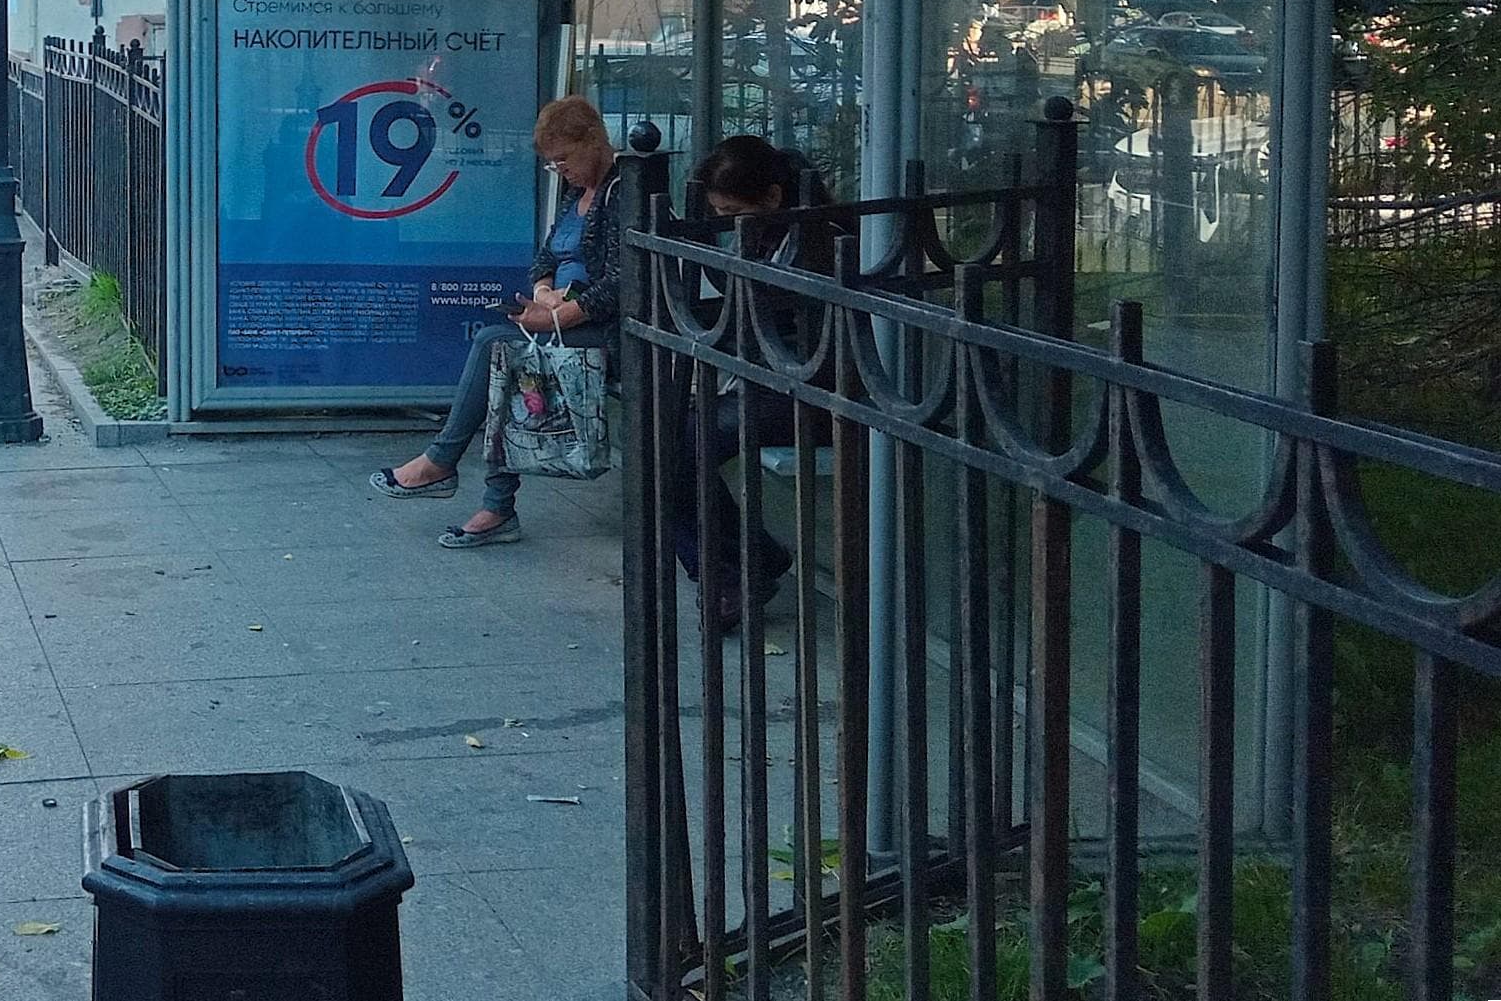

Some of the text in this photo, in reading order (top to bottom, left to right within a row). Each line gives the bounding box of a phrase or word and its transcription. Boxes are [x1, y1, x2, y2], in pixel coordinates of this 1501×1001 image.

[339, 3, 347, 14] к
[353, 0, 444, 19] большему
[234, 28, 505, 52] НАКОПИТЕЛЬНЫЙ СЧЁТ
[431, 283, 502, 291] 8 800 222 5050
[431, 295, 502, 308] www.bspb.ru
